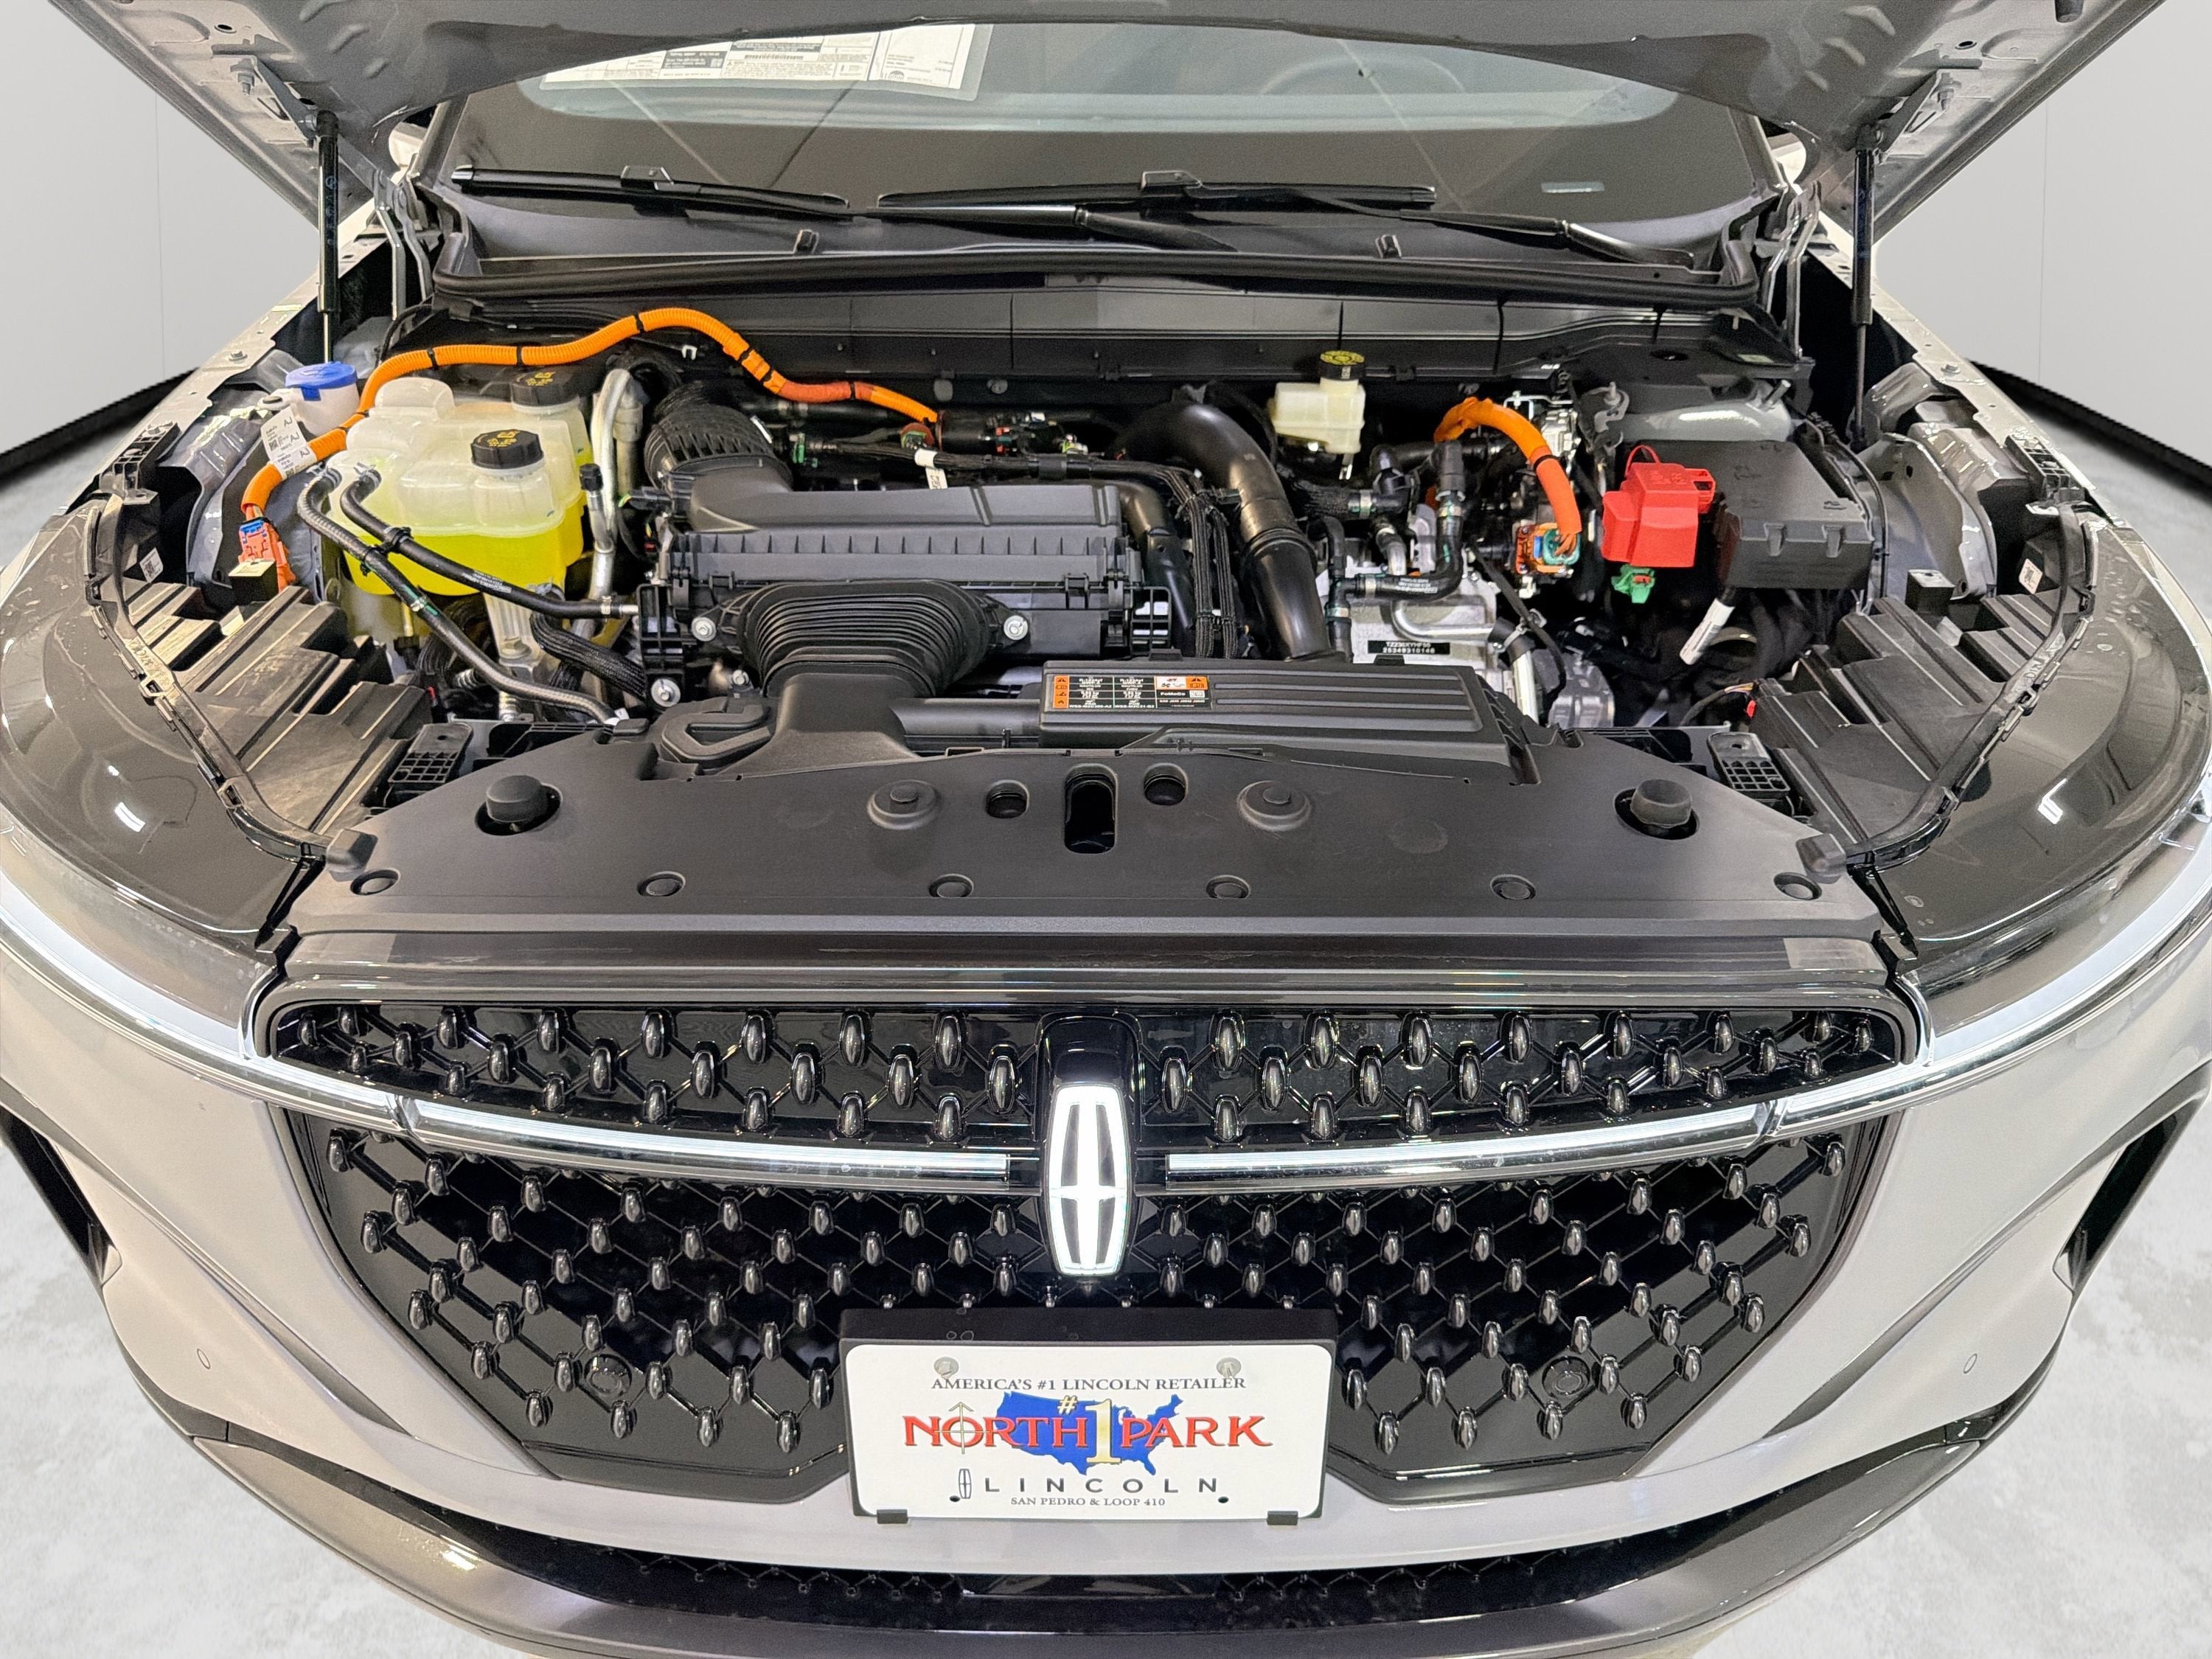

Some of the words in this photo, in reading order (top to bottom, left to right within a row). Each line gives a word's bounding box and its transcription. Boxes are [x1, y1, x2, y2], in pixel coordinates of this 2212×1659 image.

[931, 1378, 1032, 1390] AMERICA'S
[1037, 1379, 1057, 1390] #1
[1062, 1379, 1150, 1390] LINCOLN
[1155, 1377, 1247, 1389] RETAILER
[902, 1415, 1089, 1448] NORTH
[1121, 1415, 1274, 1448] PARK
[984, 1478, 1217, 1494] LINCOLN
[1010, 1497, 1036, 1506] SAN
[1039, 1497, 1086, 1506] PEDRO
[1089, 1497, 1101, 1506] &
[1103, 1497, 1141, 1506] LOOP
[1144, 1498, 1166, 1506] 410
